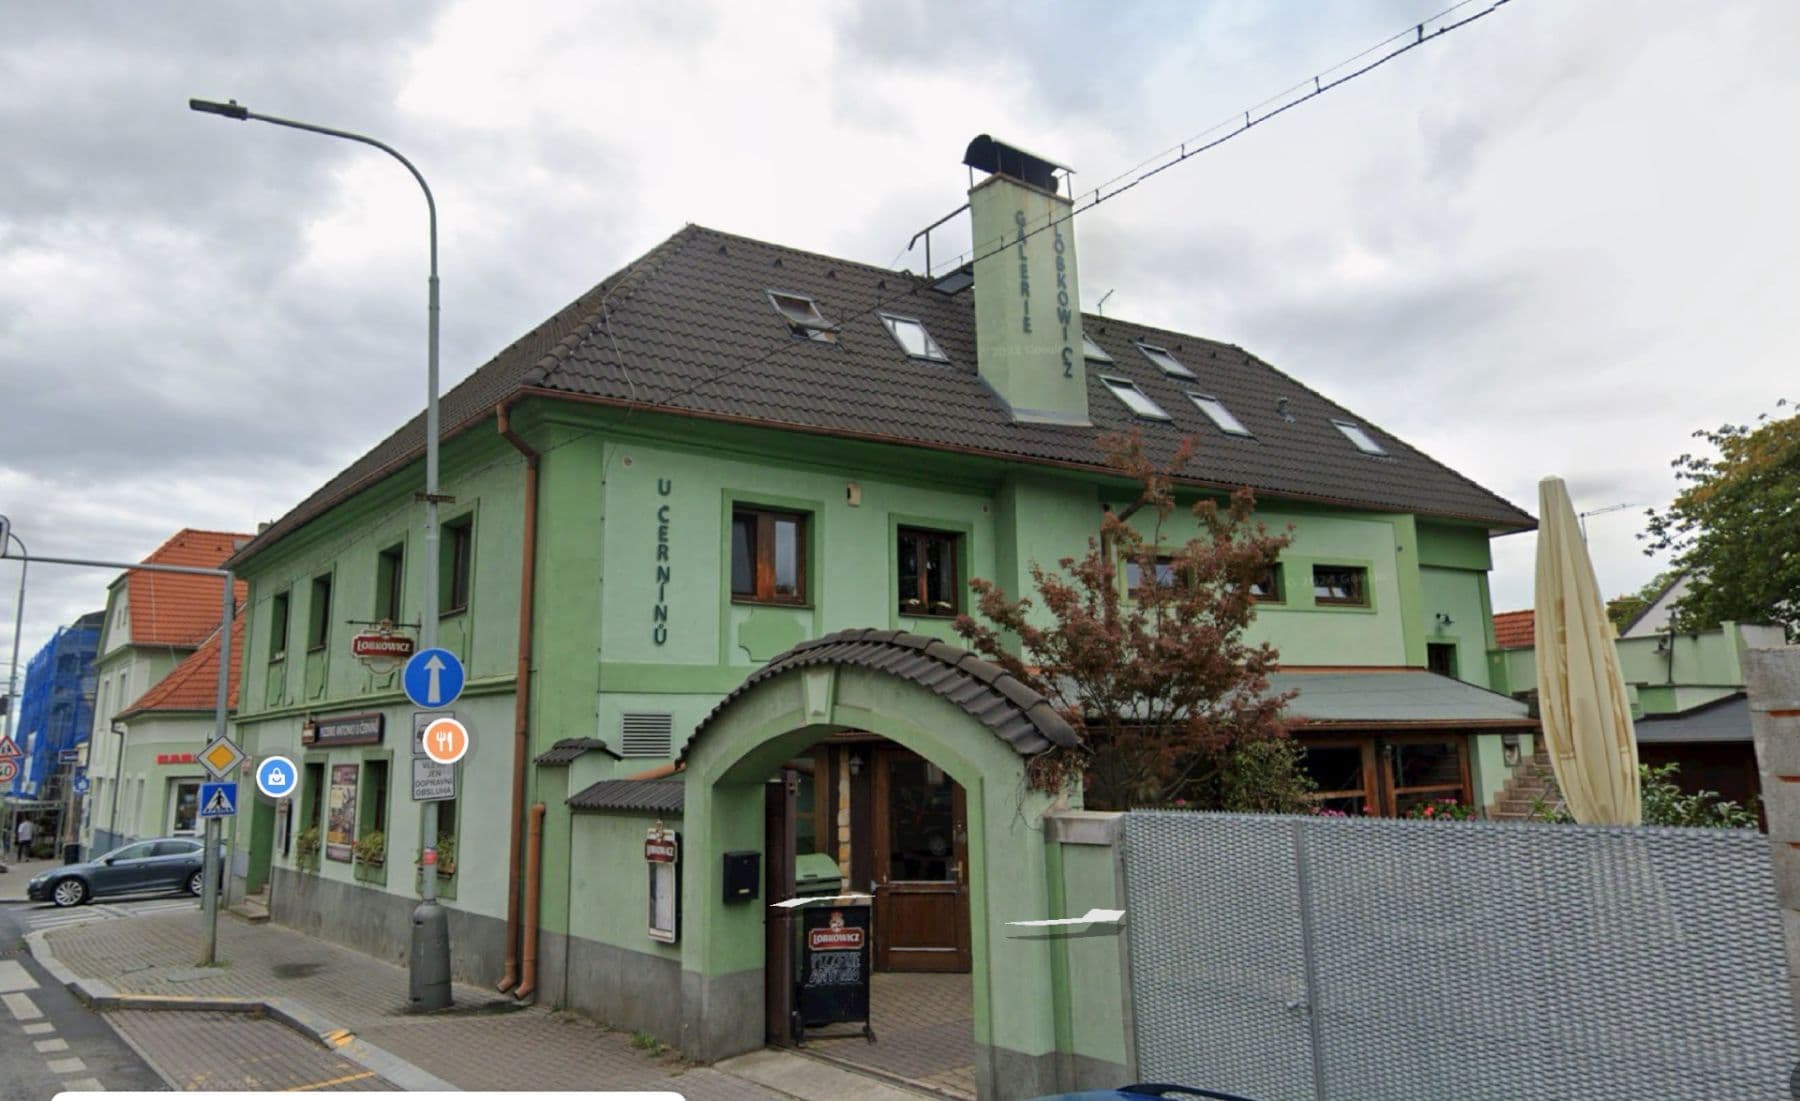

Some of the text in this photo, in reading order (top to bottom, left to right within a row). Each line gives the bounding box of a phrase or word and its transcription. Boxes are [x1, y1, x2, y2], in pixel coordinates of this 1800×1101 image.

[1016, 210, 1032, 334] GALERIE
[1054, 223, 1073, 378] LOBKOWICZ
[658, 478, 671, 496] U
